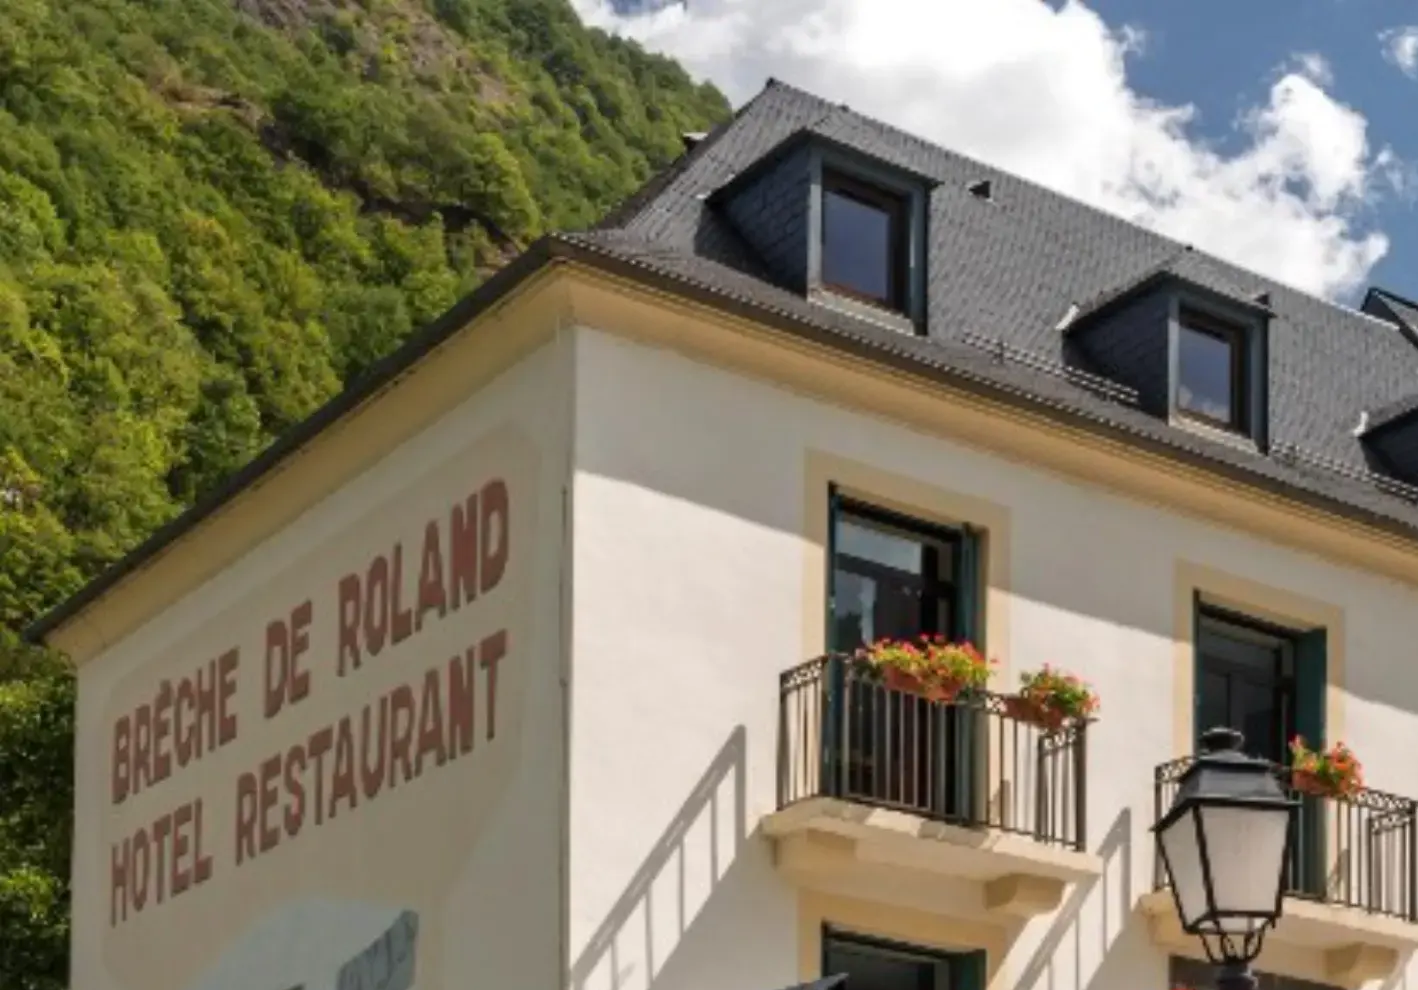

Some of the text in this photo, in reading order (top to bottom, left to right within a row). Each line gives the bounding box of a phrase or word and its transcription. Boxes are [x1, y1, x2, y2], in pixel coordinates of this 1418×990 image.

[263, 599, 313, 719] DE
[337, 477, 510, 677] ROLAND
[108, 629, 509, 929] HOTEL RESTAURANT
